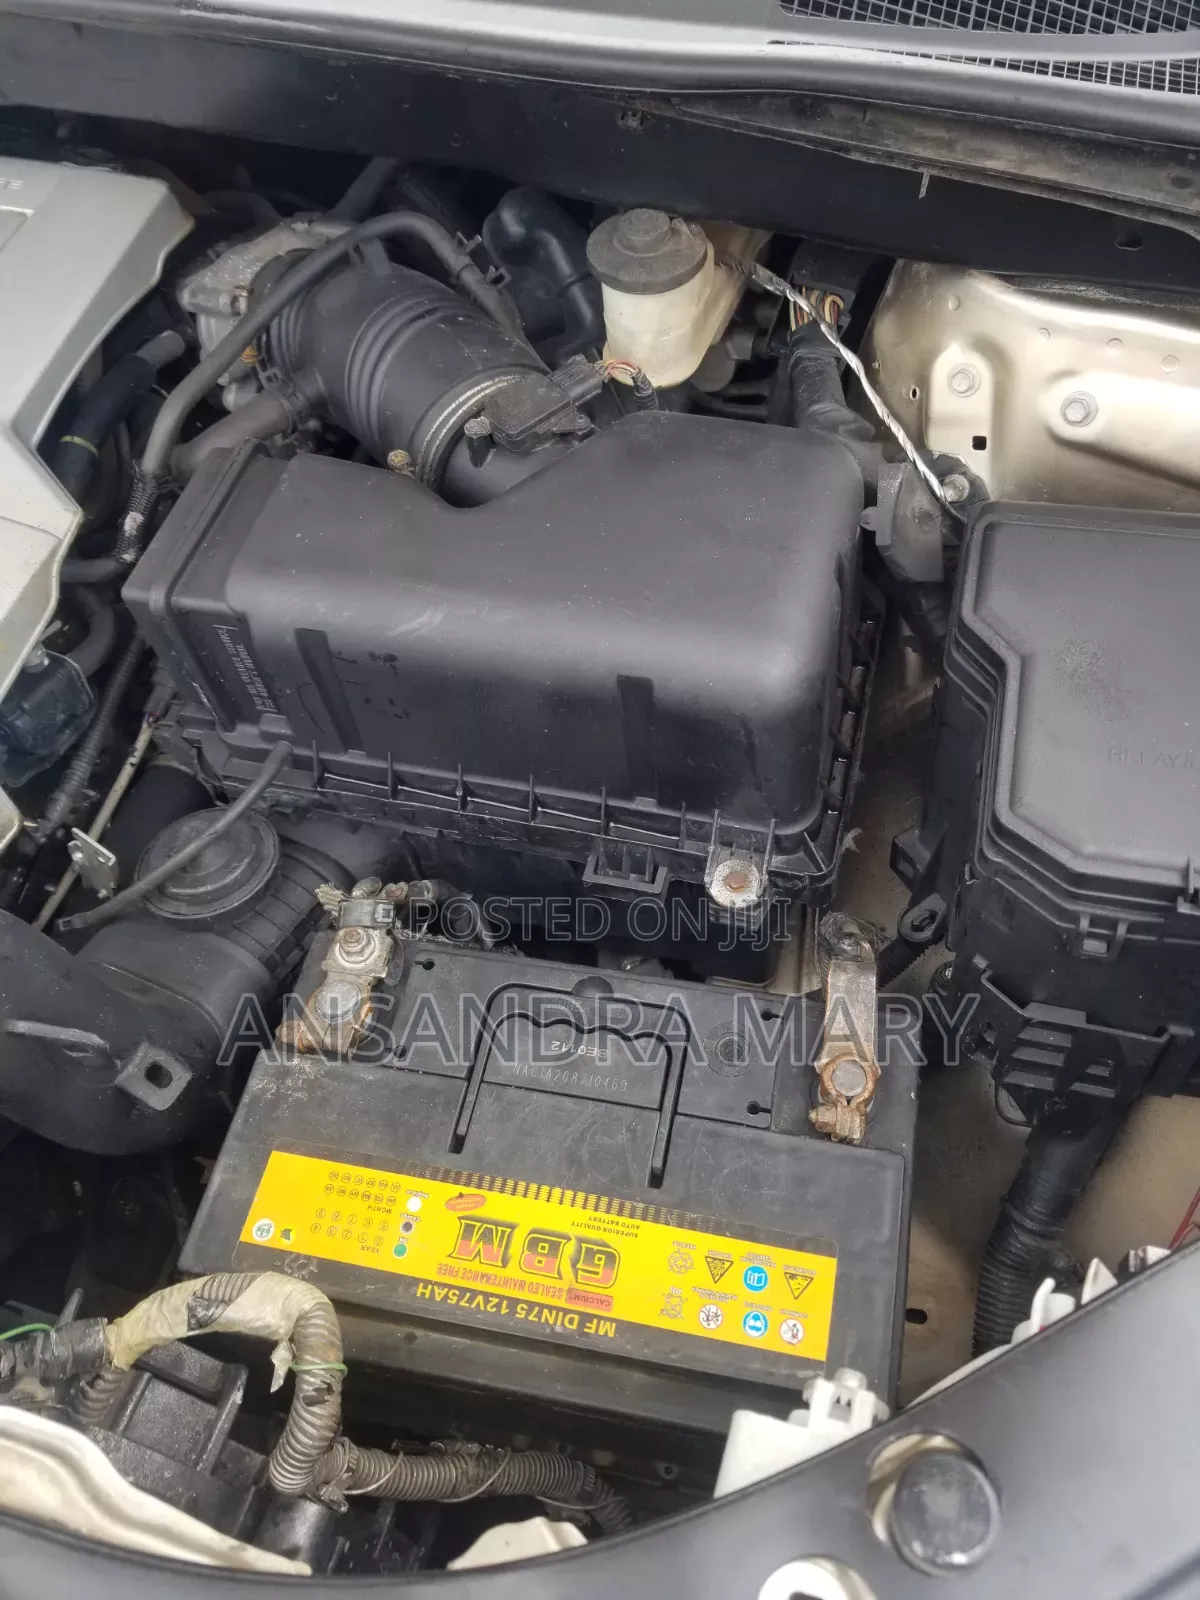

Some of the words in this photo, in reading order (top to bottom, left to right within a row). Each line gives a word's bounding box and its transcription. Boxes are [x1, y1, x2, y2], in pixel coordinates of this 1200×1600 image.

[367, 1204, 392, 1214] MONTH
[570, 1220, 601, 1231] QUALITY
[587, 1214, 619, 1226] BATTERY
[620, 1221, 640, 1230] AUTO
[601, 1226, 638, 1238] SUPERIOR
[359, 1244, 379, 1253] YEAR
[435, 1261, 459, 1278] FREE
[459, 1266, 526, 1292] MAINTENANCE
[526, 1280, 564, 1299] SEALED
[415, 1282, 510, 1315] 12V75AH
[514, 1302, 579, 1329] DIN75
[583, 1316, 616, 1337] MF
